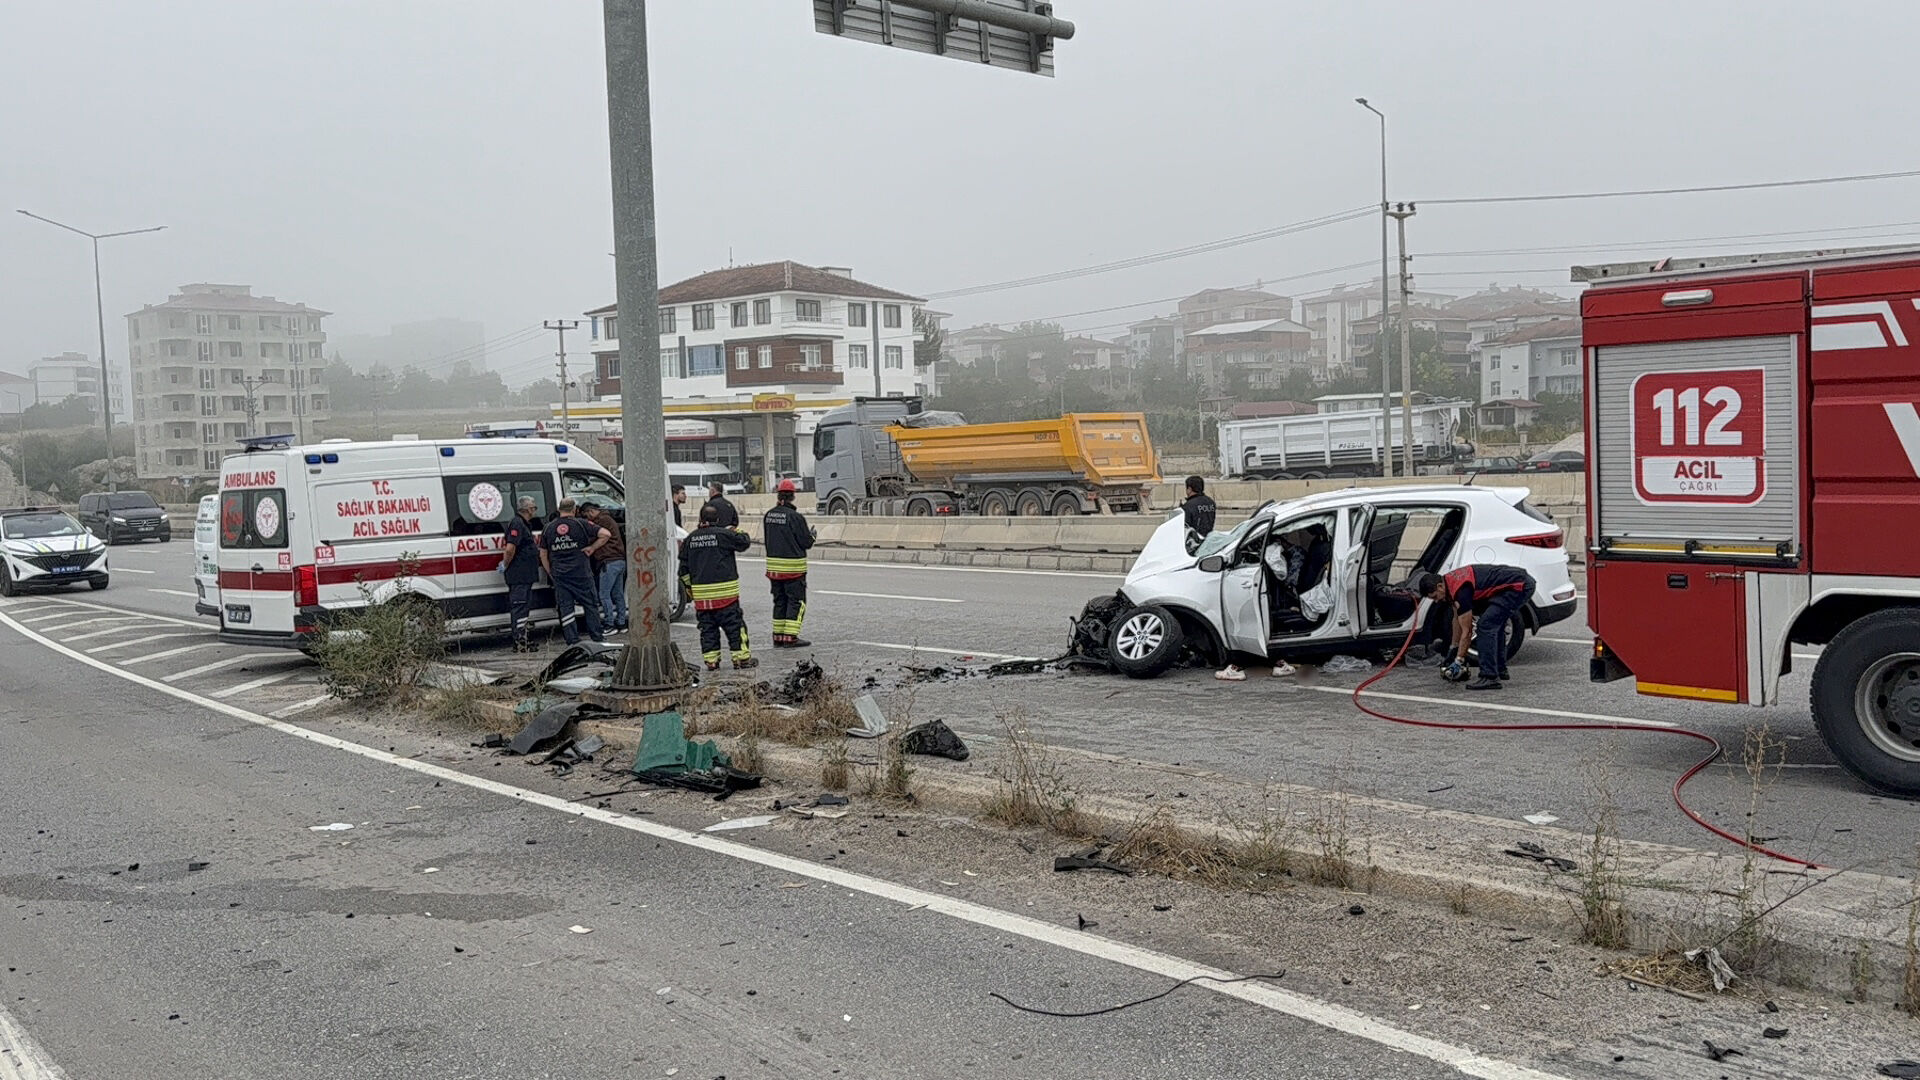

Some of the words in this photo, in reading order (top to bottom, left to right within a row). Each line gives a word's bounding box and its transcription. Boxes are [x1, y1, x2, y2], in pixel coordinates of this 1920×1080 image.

[1652, 385, 1743, 447] 112
[1674, 460, 1723, 479] ACİL
[224, 470, 276, 488] AMBULANS
[1680, 480, 1718, 493] ÇAĞRI
[372, 480, 394, 495] T.C.
[337, 498, 375, 517] SAĞLIK
[377, 495, 431, 514] BAKANLIĞI
[353, 518, 378, 537] ACİL
[381, 516, 421, 535] SAĞLIK
[457, 537, 488, 552] ACİL
[555, 534, 574, 543] ACİL
[691, 533, 717, 542] SAMSUN
[318, 547, 333, 558] 112
[551, 541, 578, 552] SAĞLIK
[279, 553, 290, 564] 112
